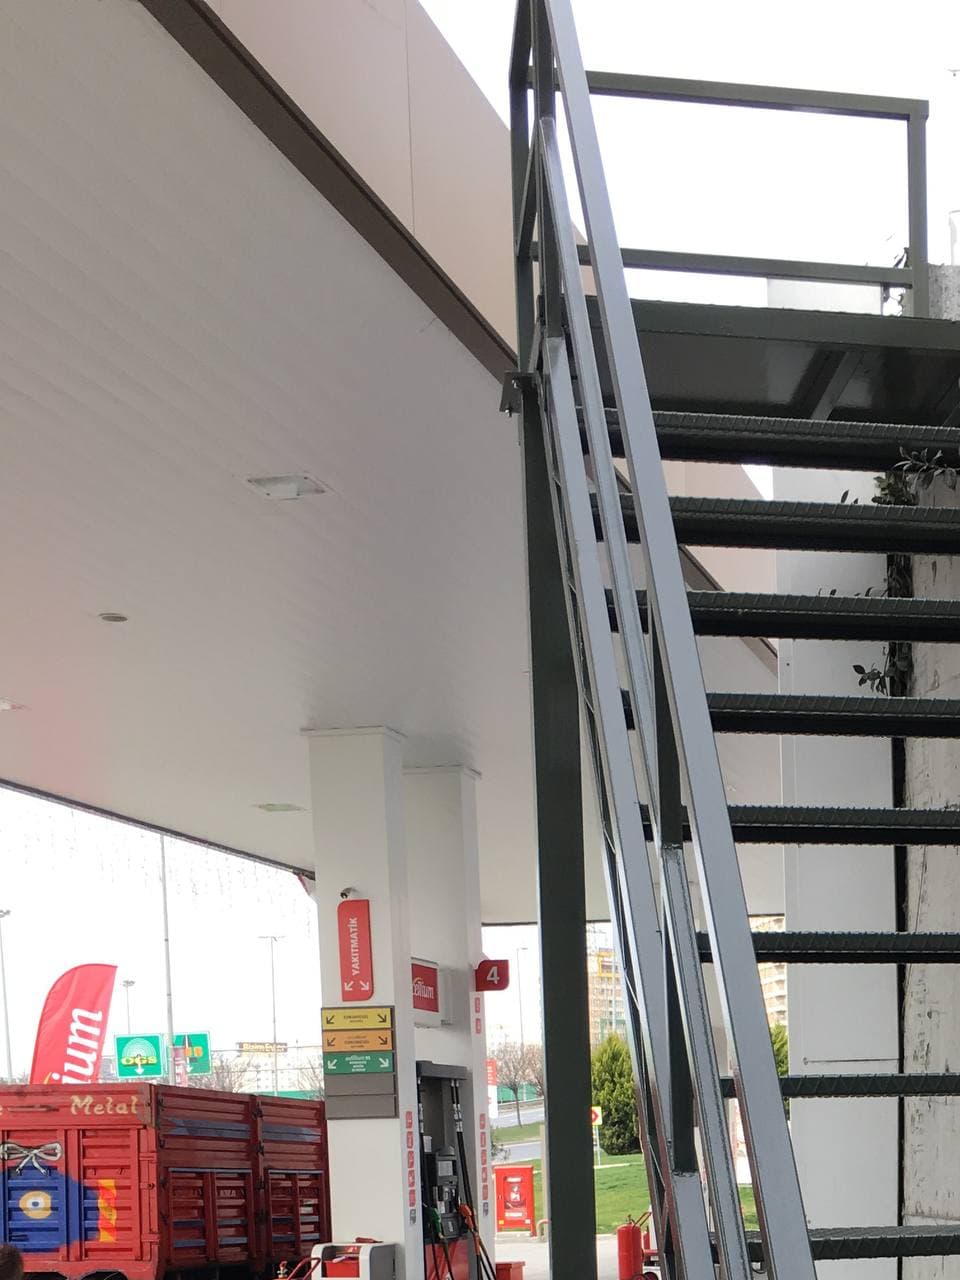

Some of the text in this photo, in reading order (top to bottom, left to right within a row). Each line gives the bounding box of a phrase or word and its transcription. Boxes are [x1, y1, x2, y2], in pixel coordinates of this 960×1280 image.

[347, 917, 360, 976] YAKITMATİK
[486, 966, 500, 985] 4
[120, 1055, 157, 1066] OGS
